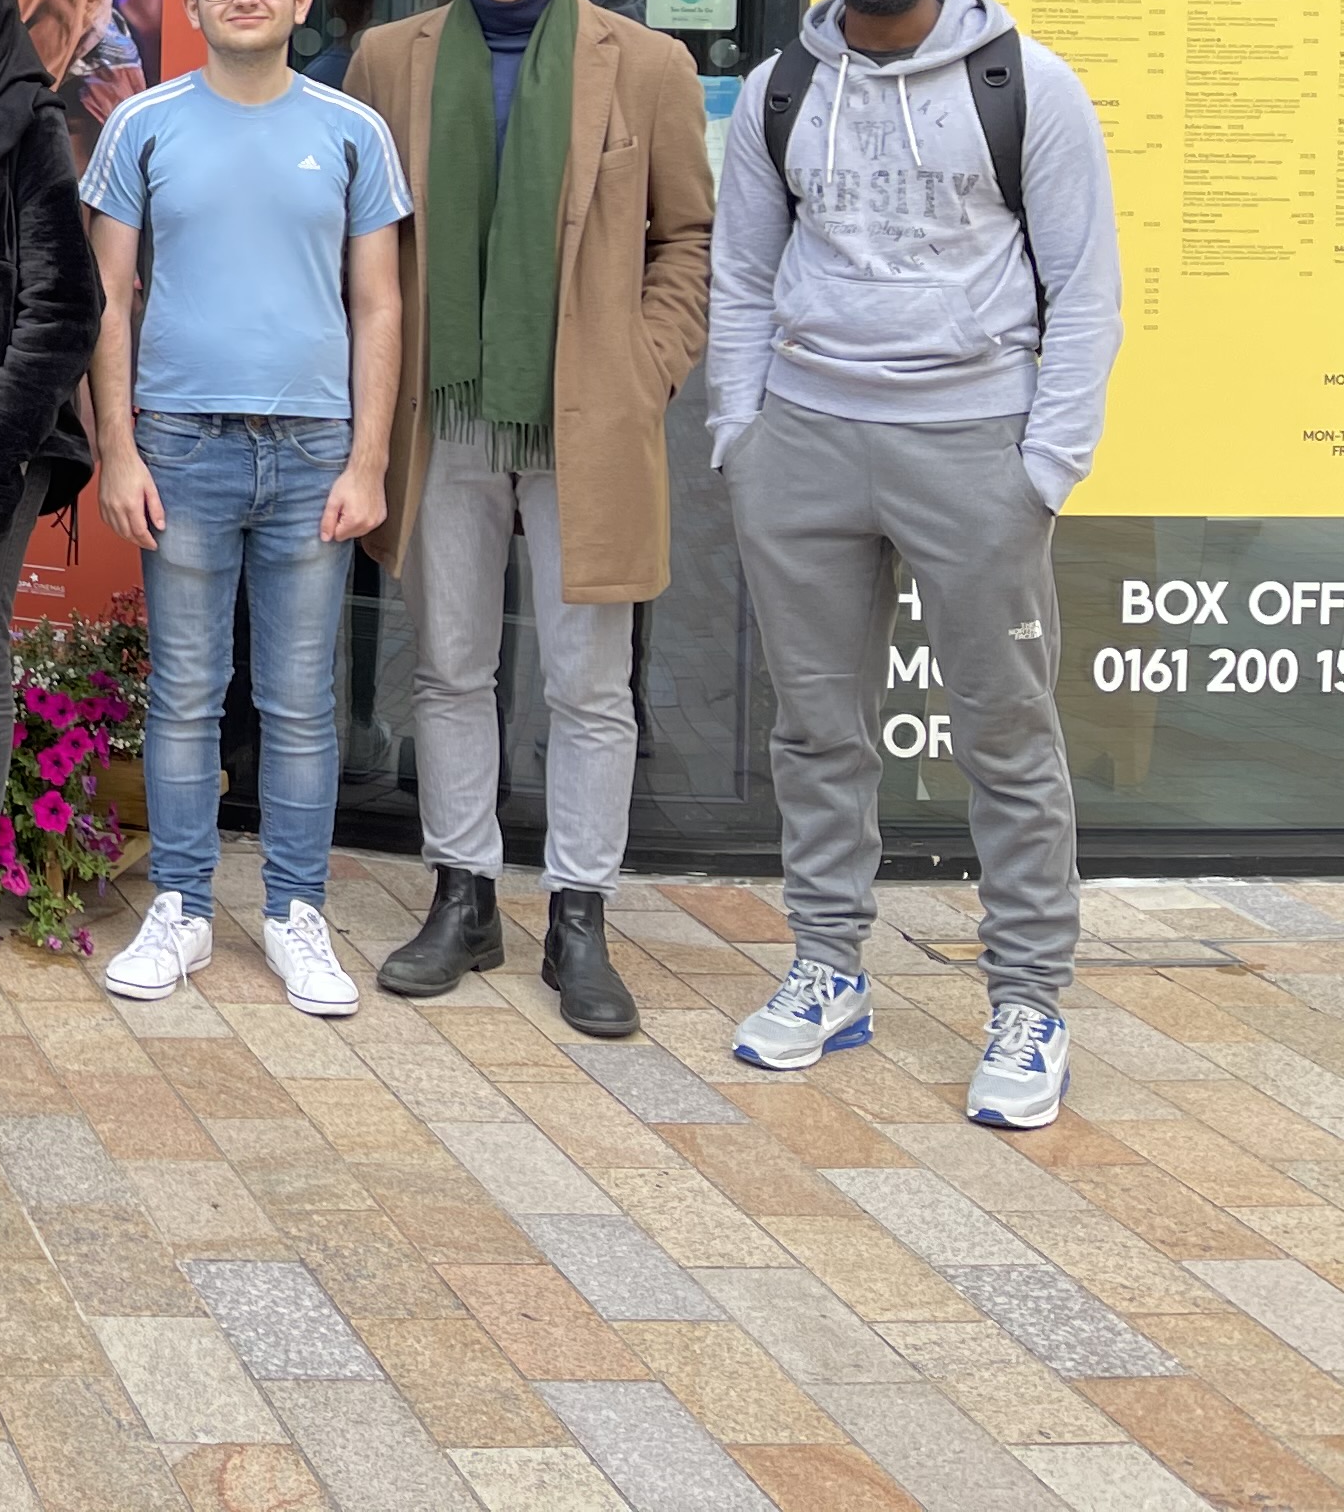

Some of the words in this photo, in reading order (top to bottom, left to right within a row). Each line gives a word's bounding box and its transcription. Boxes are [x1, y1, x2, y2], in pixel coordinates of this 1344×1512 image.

[785, 168, 980, 225] VARSITY
[1121, 580, 1229, 625] BOX
[1093, 647, 1188, 693] 0161
[1206, 648, 1299, 694] 200
